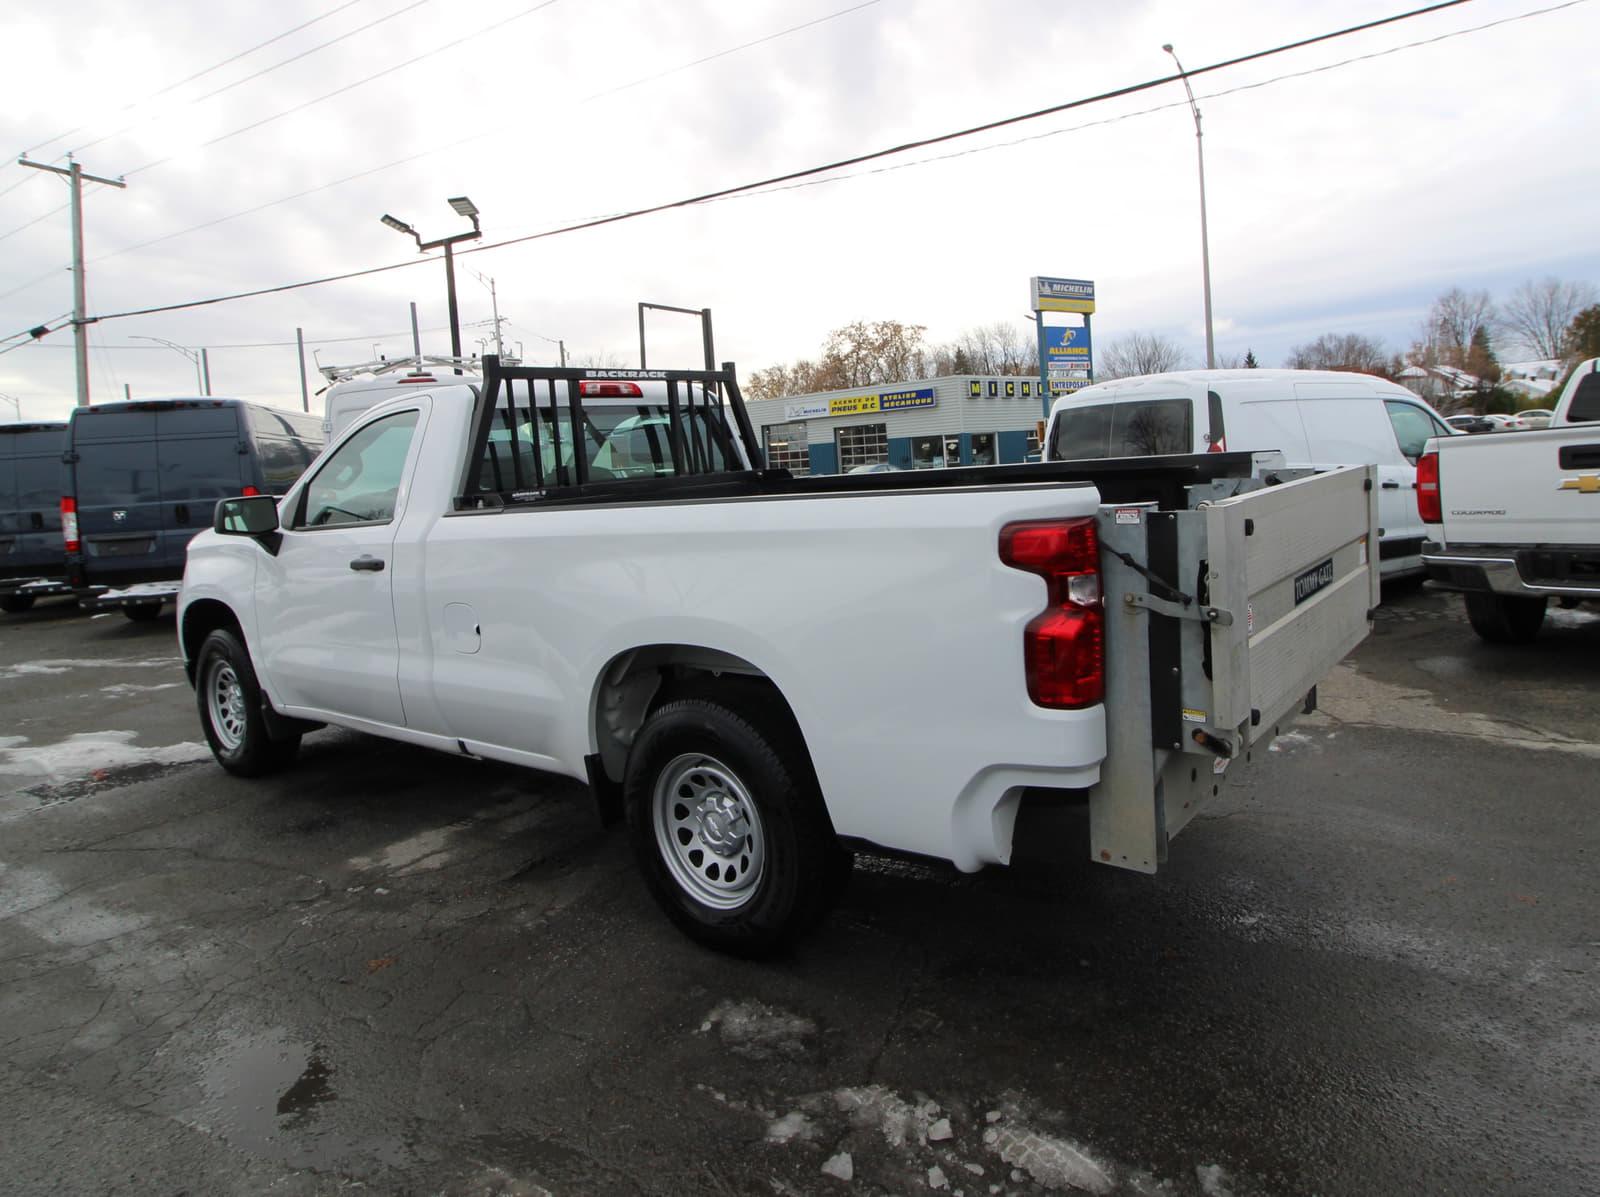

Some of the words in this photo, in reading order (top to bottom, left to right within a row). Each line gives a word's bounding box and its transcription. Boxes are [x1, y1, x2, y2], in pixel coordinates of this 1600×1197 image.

[1052, 283, 1093, 294] MICHELIN
[585, 370, 667, 378] BACKRACK
[971, 381, 1043, 396] MICH
[883, 392, 917, 401] ATELIER
[831, 405, 858, 413] PNEUS
[1296, 572, 1318, 600] TOMMY
[1319, 563, 1333, 585] GATE
